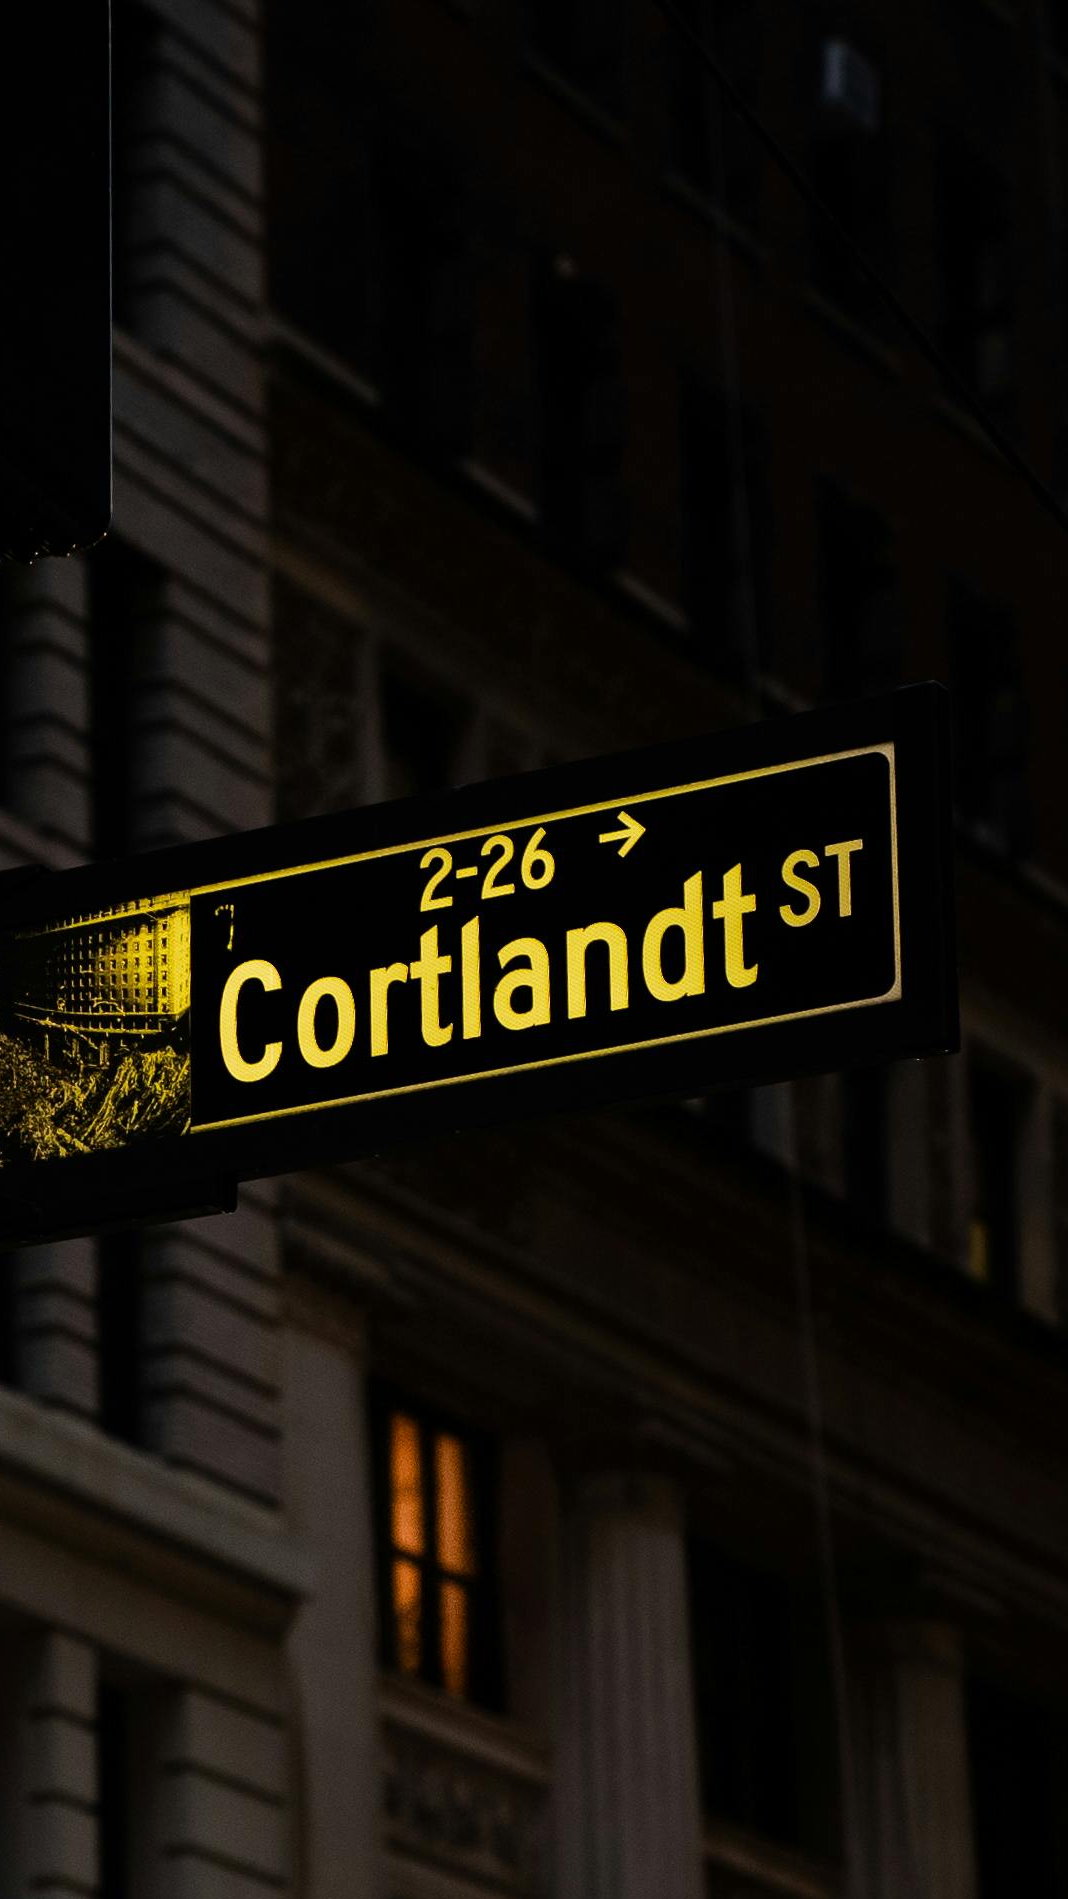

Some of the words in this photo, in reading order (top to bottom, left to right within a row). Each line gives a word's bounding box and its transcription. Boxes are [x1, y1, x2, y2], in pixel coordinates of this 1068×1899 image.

[418, 826, 557, 913] 2-26
[217, 867, 760, 1084] Cortlandt
[777, 837, 866, 930] ST
